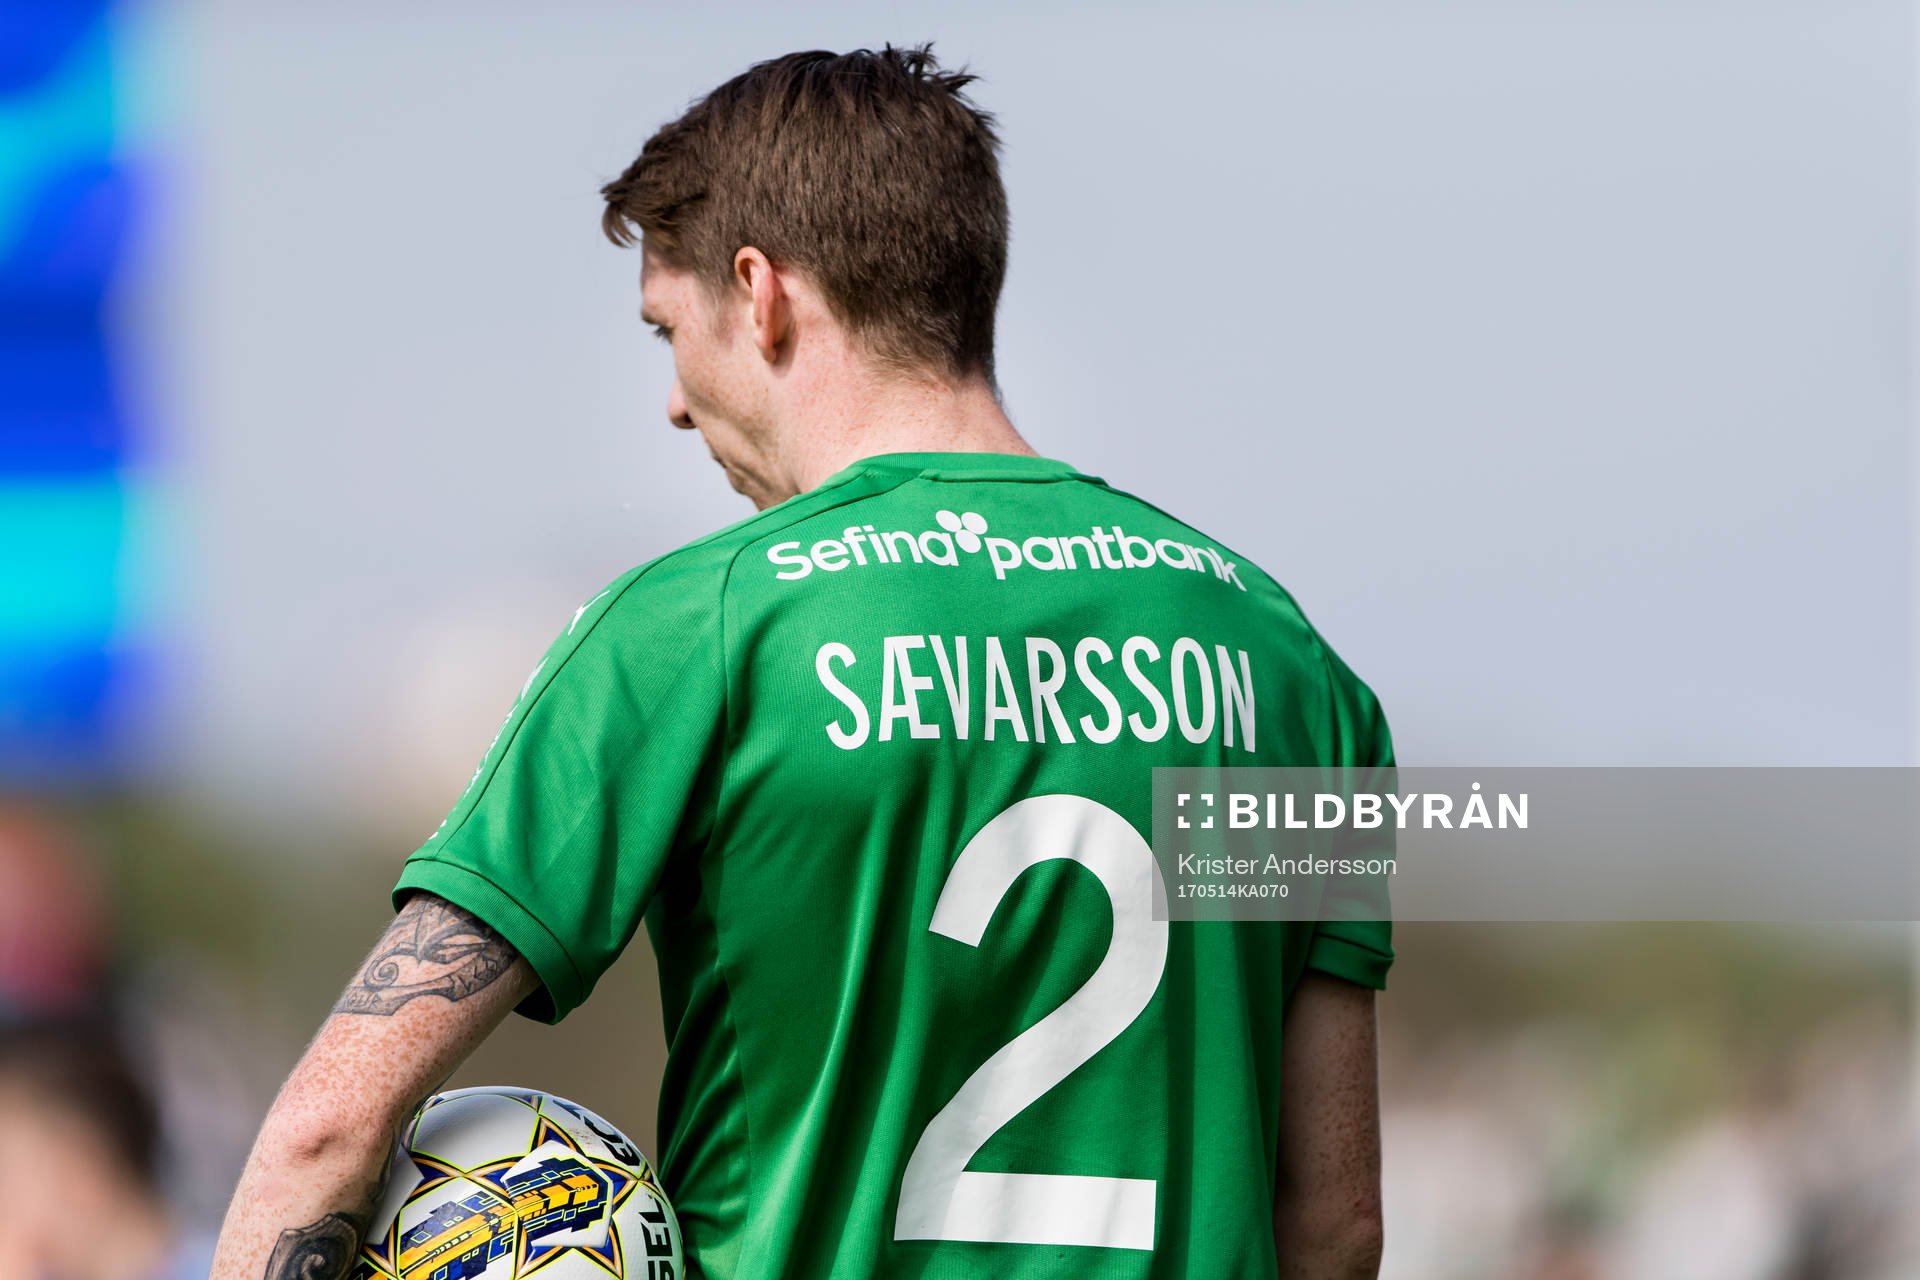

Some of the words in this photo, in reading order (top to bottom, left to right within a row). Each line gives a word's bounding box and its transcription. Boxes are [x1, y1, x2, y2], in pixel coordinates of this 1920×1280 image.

[766, 524, 959, 581] Sefina
[985, 525, 1248, 592] pantbank
[814, 634, 1256, 753] SÆVARSSON
[893, 793, 1170, 1251] 2
